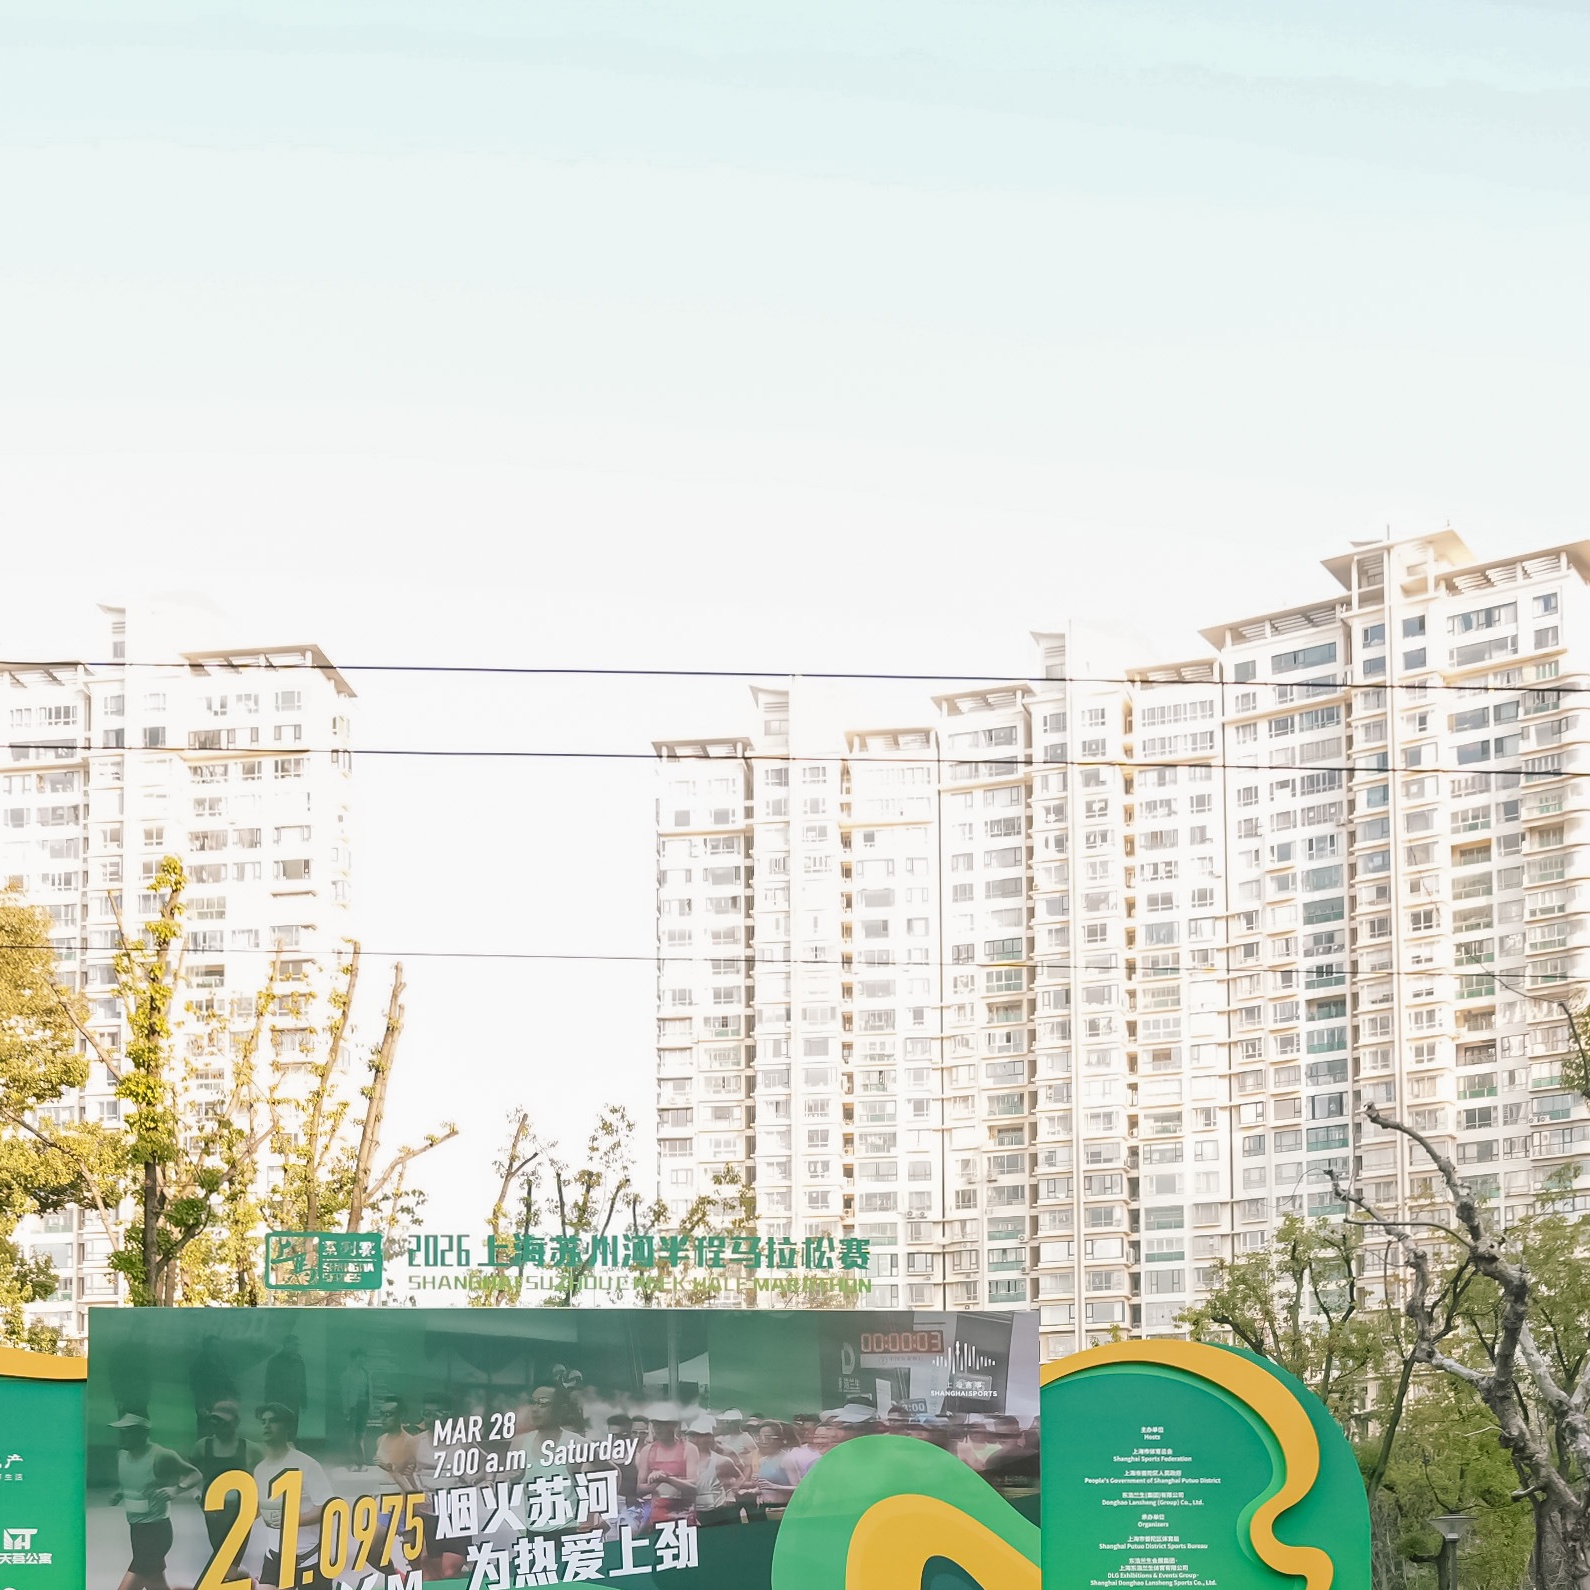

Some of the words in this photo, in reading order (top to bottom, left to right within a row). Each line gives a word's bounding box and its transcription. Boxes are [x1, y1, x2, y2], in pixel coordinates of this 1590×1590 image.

[409, 1234, 470, 1266] 2026
[478, 1233, 870, 1270] 上海苏州河半程马拉松赛
[753, 1277, 872, 1293] MARATHON
[861, 1331, 942, 1352] 00:00:03
[433, 1419, 483, 1447] MAR
[489, 1412, 516, 1441] 28
[433, 1447, 479, 1479] 7:00
[485, 1447, 532, 1474] a.m.
[540, 1433, 639, 1470] Saturday
[434, 1470, 620, 1541] 烟火苏河
